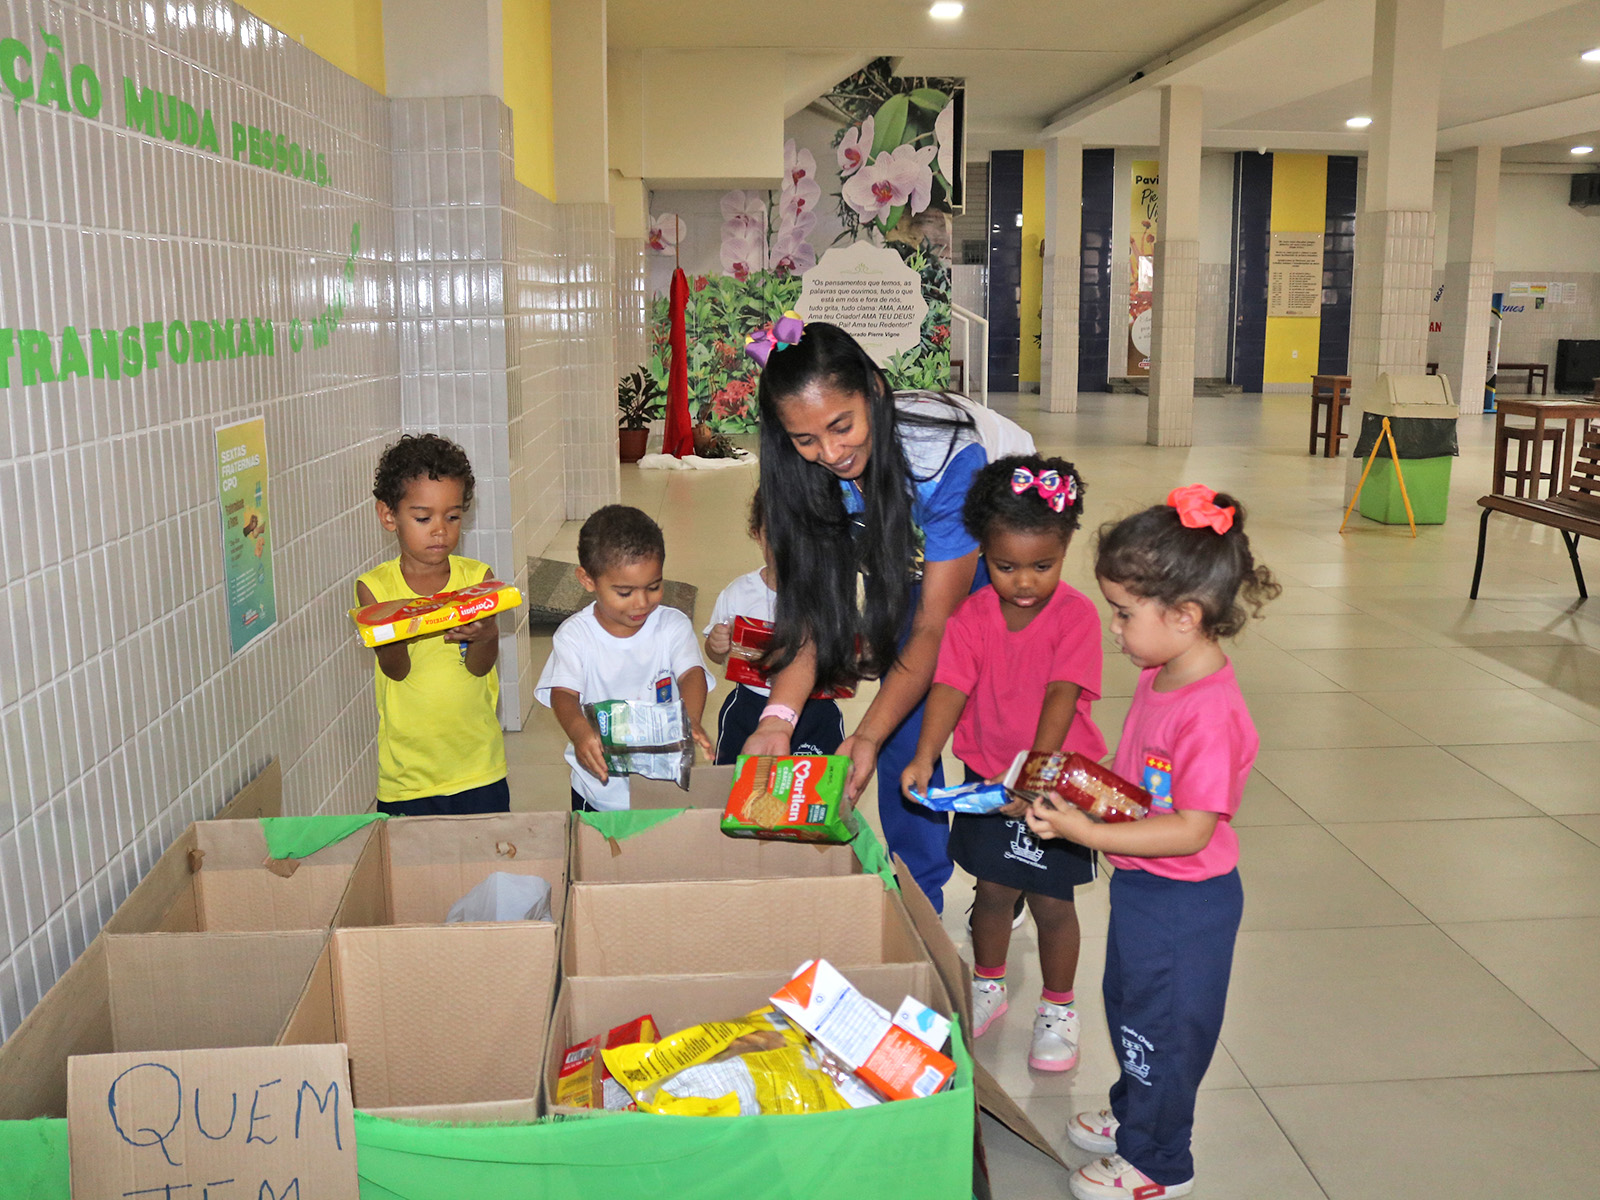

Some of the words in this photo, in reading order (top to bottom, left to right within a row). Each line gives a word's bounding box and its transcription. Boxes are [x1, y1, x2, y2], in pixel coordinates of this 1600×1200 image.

[0, 22, 102, 119] ÇÃO
[123, 76, 219, 154] MUDA
[824, 280, 867, 288] pensamentos
[289, 317, 302, 353] O
[221, 444, 247, 464] SEXTAS
[221, 453, 260, 478] FRATERNAS
[222, 476, 238, 492] CPO
[461, 598, 494, 615] Marilan
[788, 760, 812, 821] Marilan
[107, 1062, 343, 1167] QUEM
